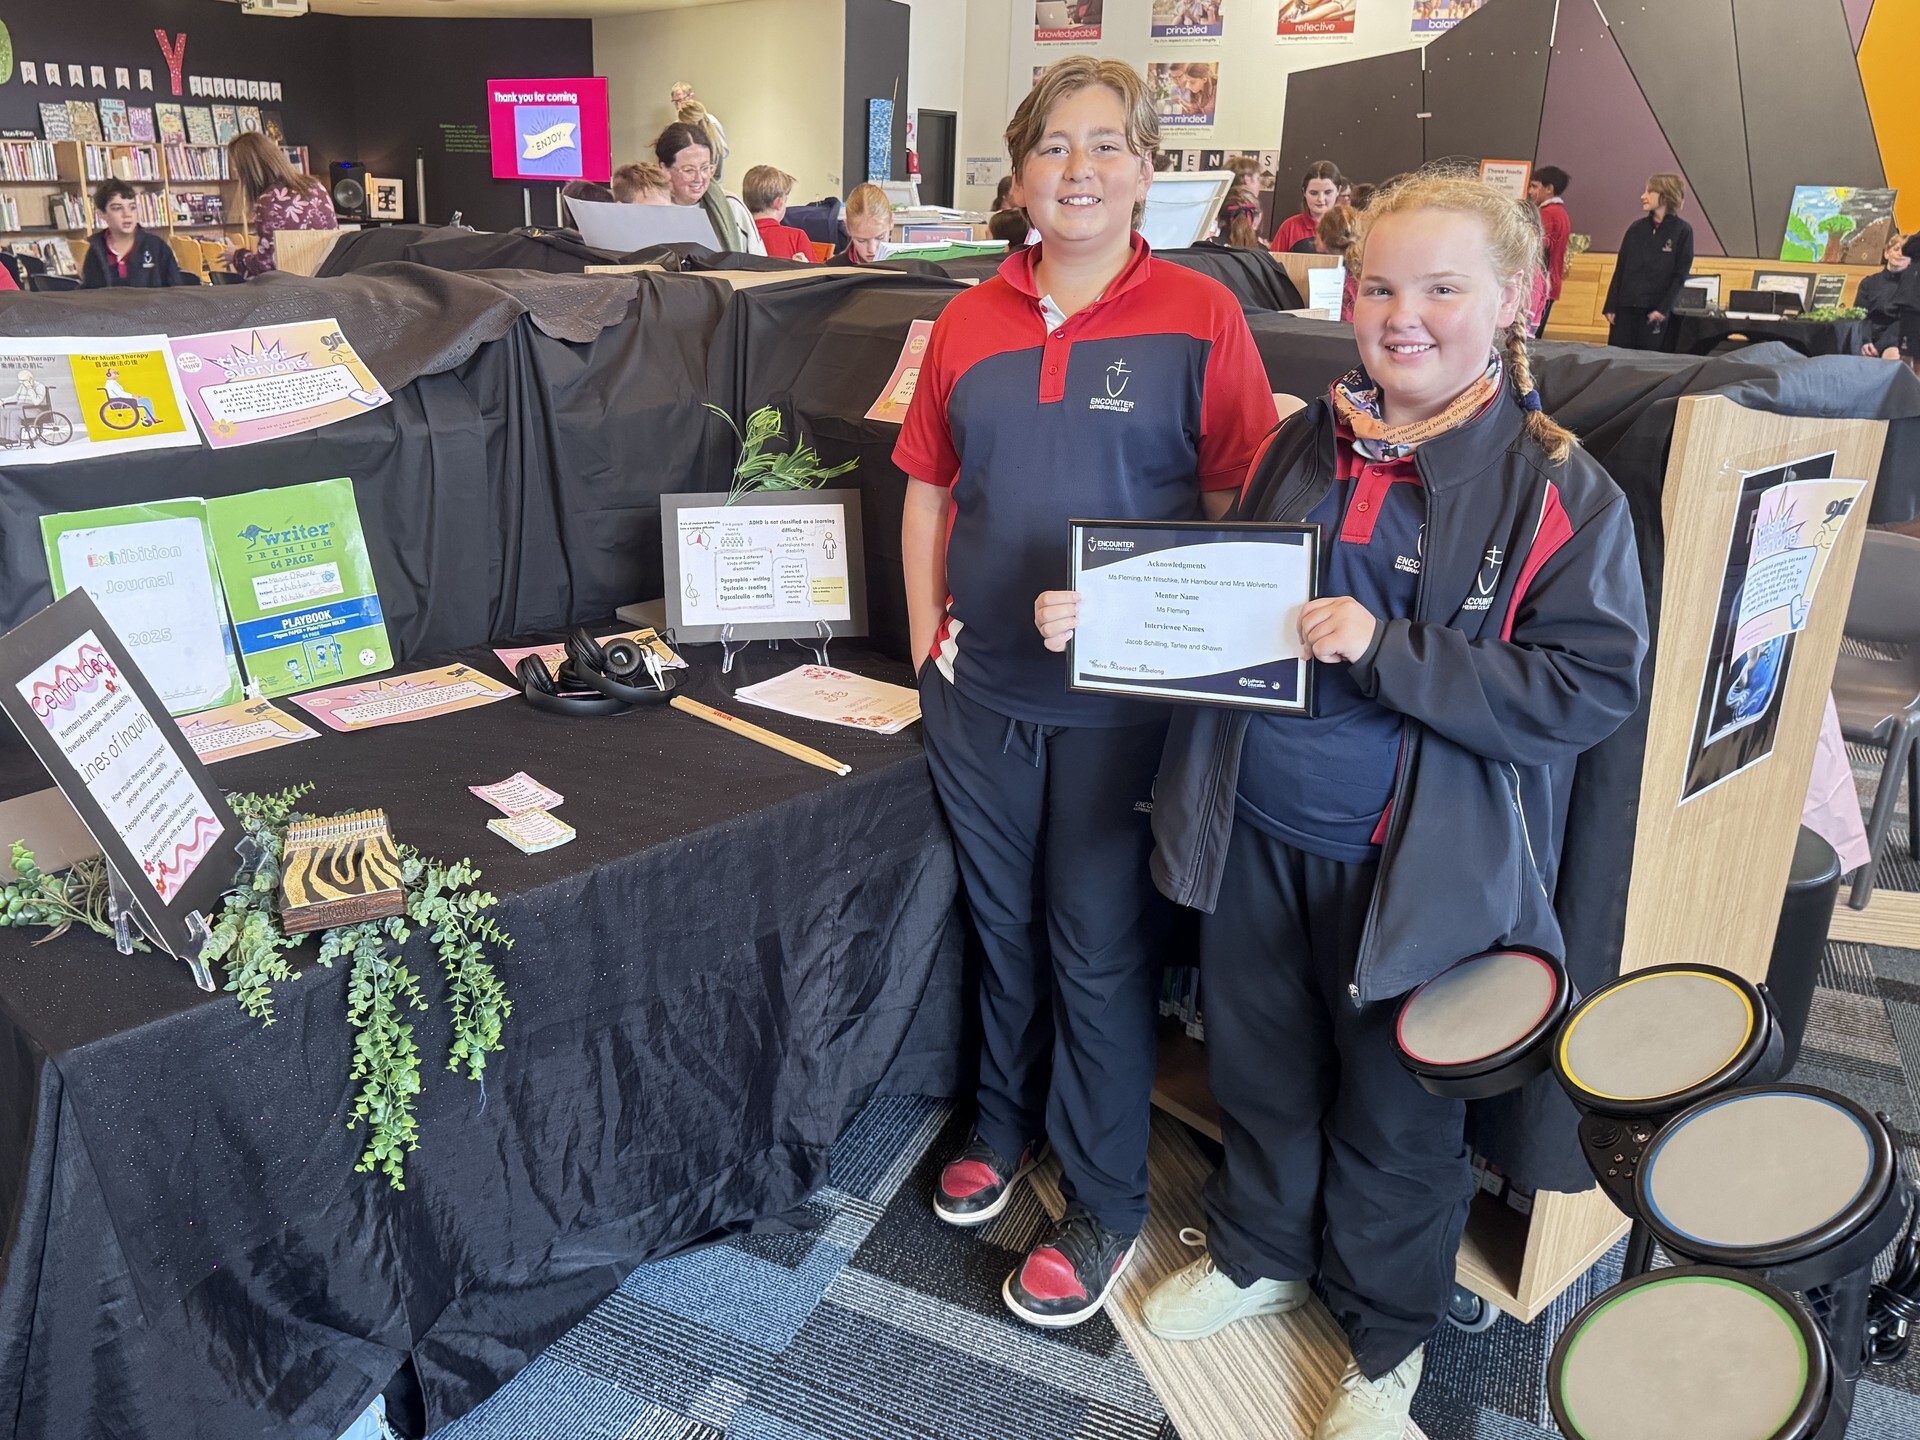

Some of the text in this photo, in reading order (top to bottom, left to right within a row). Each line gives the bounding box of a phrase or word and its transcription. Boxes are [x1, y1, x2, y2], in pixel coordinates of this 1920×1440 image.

[1166, 25, 1208, 36] principled
[1295, 22, 1336, 32] reflective
[1428, 19, 1460, 29] balan
[1038, 28, 1098, 39] knowledgeable
[154, 28, 187, 96] Y
[494, 92, 577, 104] Thank you for coming
[1174, 114, 1206, 123] minded
[536, 132, 562, 150] ENJOY
[218, 348, 287, 368] tips for
[224, 359, 312, 380] everyone.
[1090, 397, 1134, 408] ENCOUNTER
[1398, 419, 1429, 436] Hansford
[1402, 425, 1432, 441] Harward
[87, 545, 182, 568] Exhibition
[246, 539, 332, 561] PREMIUM
[271, 554, 314, 569] 64 PAGE
[1147, 561, 1206, 570] Acknowledgments
[106, 571, 174, 594] Journal
[1118, 574, 1142, 582] Fleming,
[1167, 607, 1190, 615] Fleming
[281, 610, 332, 629] PLAYBOOK
[1144, 622, 1181, 631] Interviewee
[128, 627, 172, 646] 2025
[1144, 640, 1169, 649] Schilling,
[32, 653, 111, 718] Central Idea
[59, 719, 82, 740] Humans
[80, 710, 94, 723] have
[65, 732, 88, 754] towards
[86, 720, 104, 740] people
[102, 712, 112, 724] with
[109, 735, 123, 758] of
[117, 710, 153, 748] Inquiry
